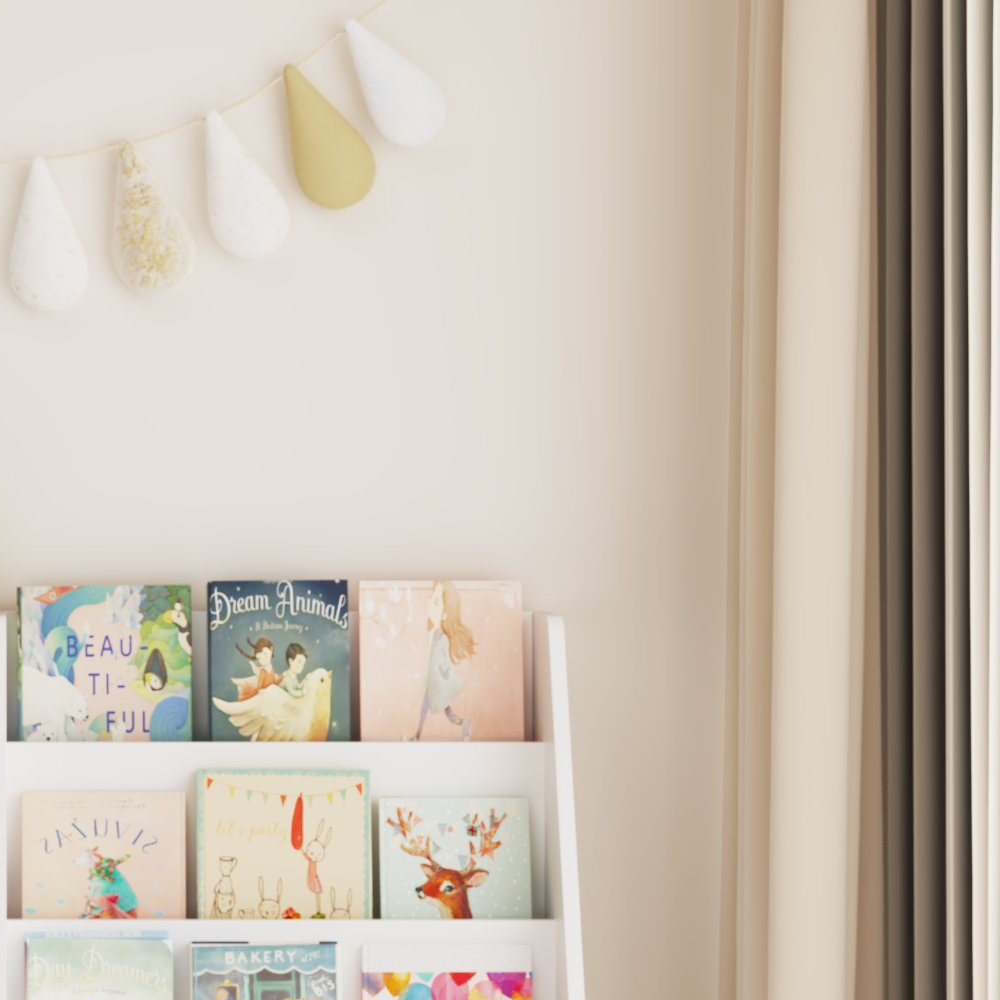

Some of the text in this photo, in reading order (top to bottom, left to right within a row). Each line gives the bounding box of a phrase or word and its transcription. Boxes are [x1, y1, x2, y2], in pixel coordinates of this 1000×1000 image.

[209, 579, 349, 631] Dream Animals
[106, 710, 151, 735] FUL
[27, 945, 168, 994] Day Dreamers
[224, 950, 298, 964] BAKERY
